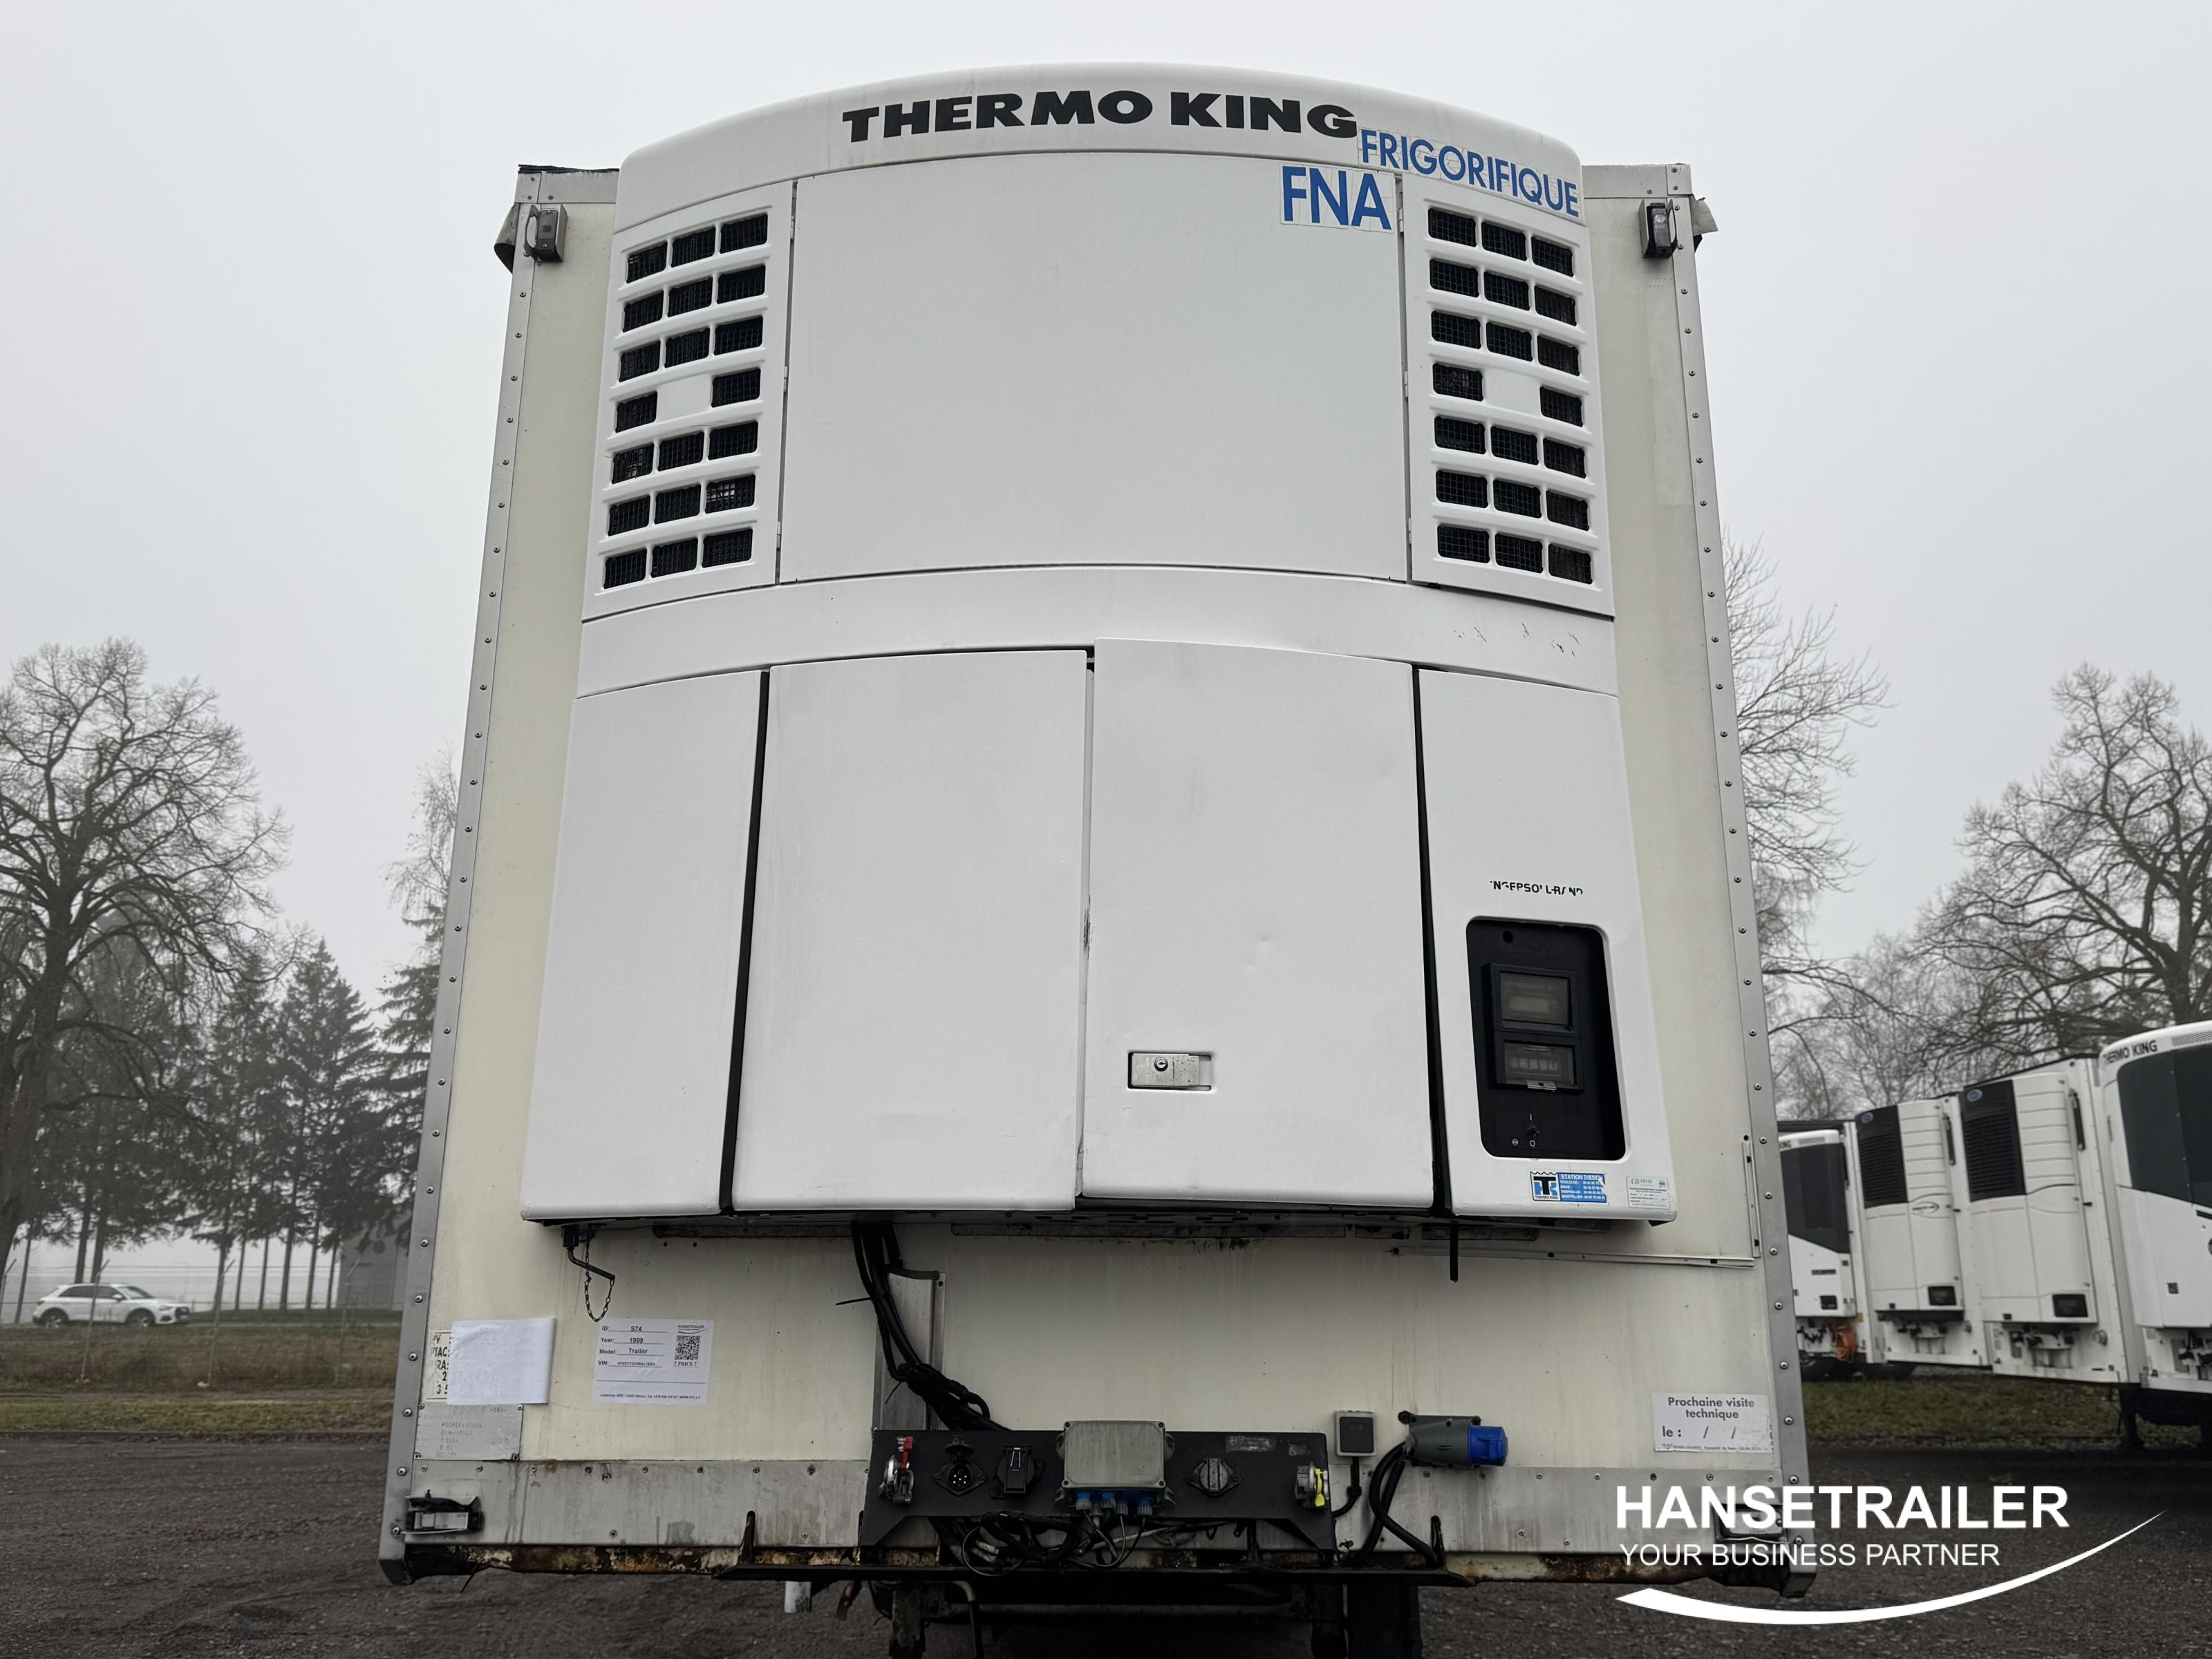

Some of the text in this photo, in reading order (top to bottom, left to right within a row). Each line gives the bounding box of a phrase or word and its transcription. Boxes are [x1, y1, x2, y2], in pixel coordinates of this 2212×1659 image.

[842, 90, 1358, 142] THERMO KING
[1361, 129, 1580, 217] FRIGORIFIQUE
[1282, 165, 1392, 231] FNA
[2132, 1040, 2157, 1056] KING
[1667, 1396, 1755, 1407] Prochaine visite
[1685, 1408, 1739, 1421] technique
[1662, 1425, 1674, 1437] le
